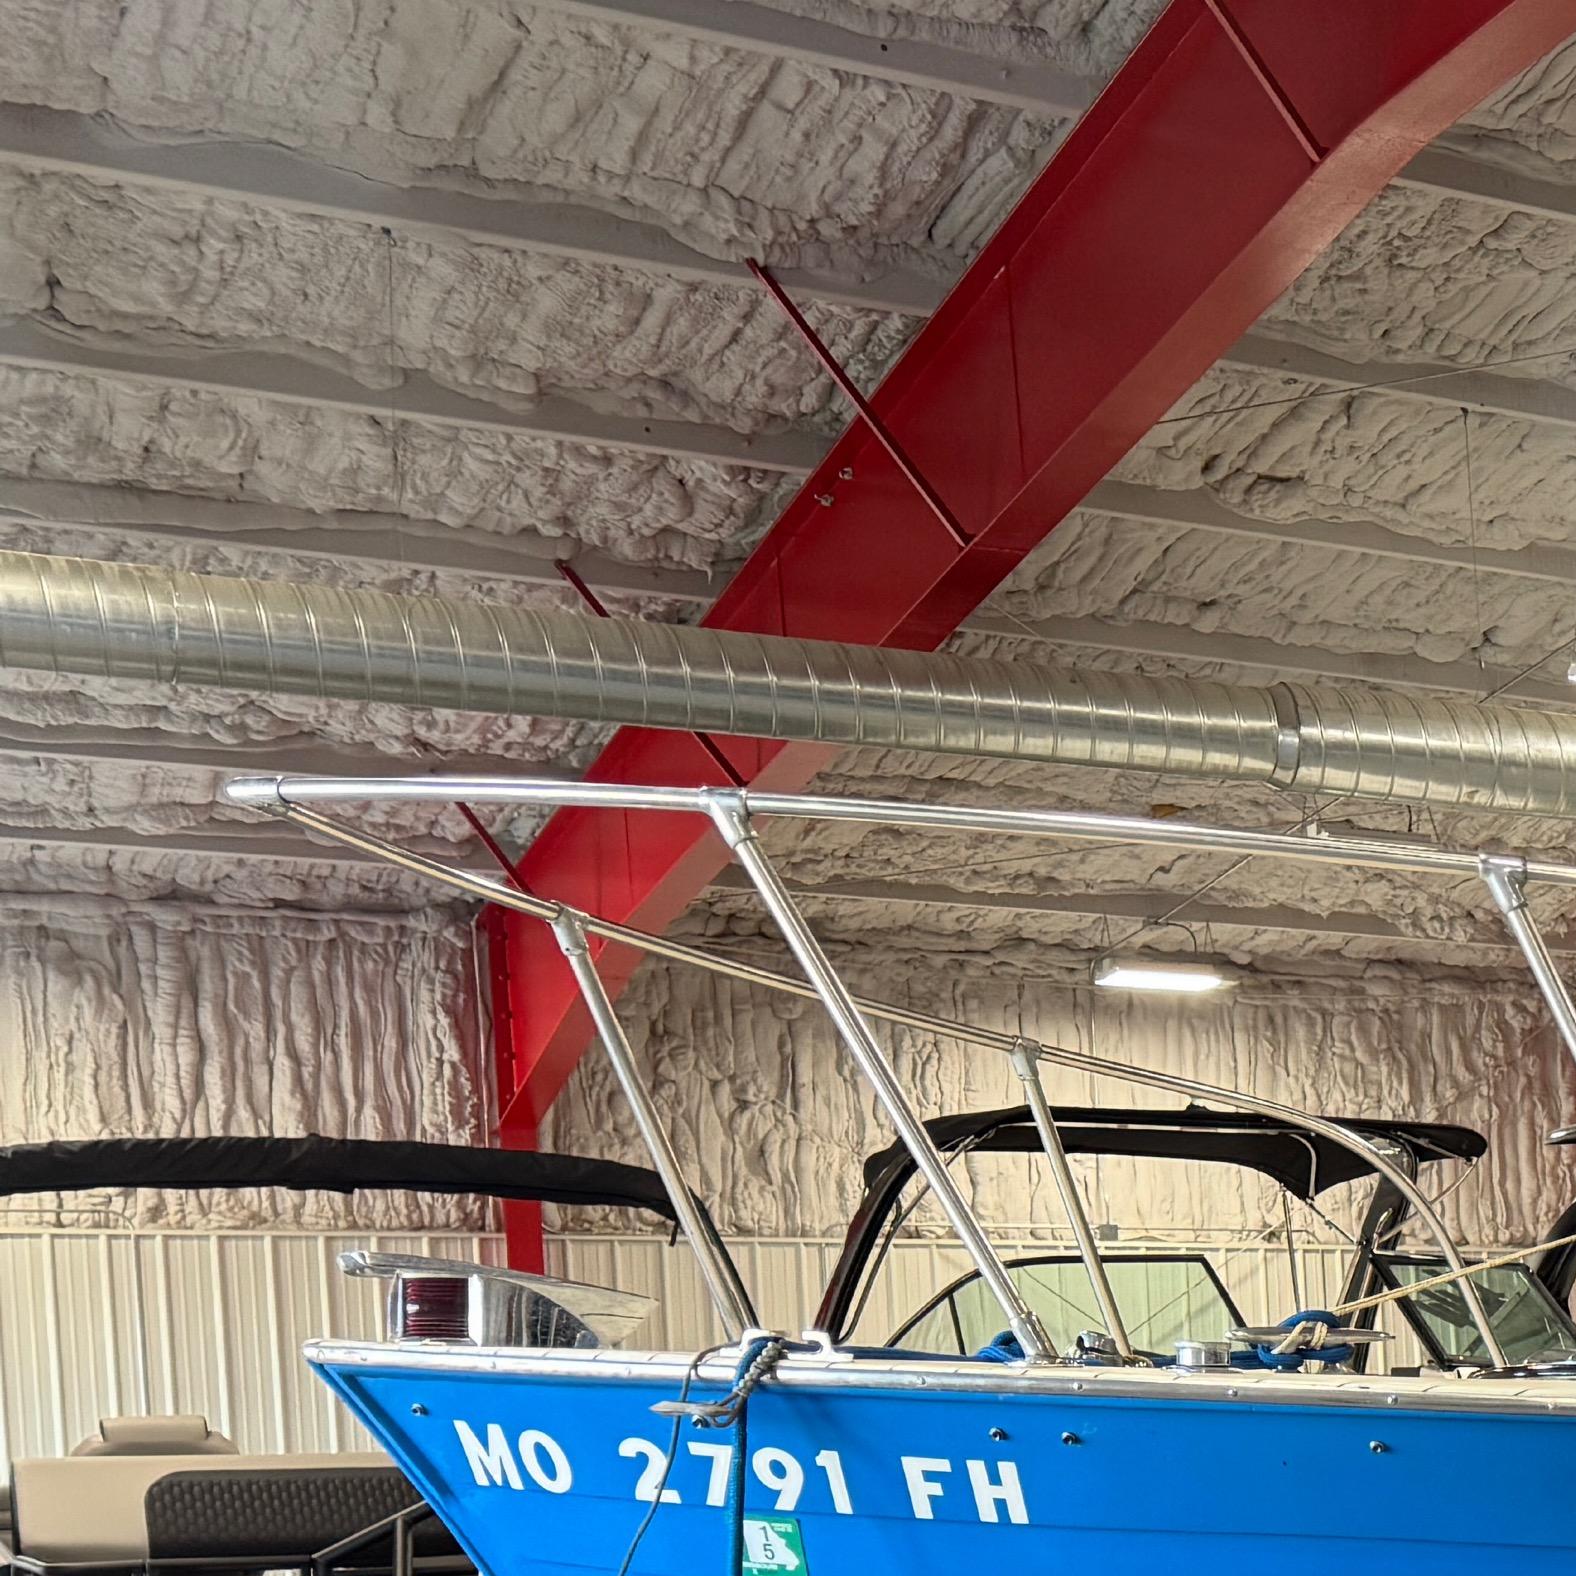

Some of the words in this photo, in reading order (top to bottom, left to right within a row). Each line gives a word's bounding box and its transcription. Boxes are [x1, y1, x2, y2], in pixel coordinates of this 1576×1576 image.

[453, 1420, 574, 1494] MO
[618, 1437, 853, 1515] 2791
[901, 1456, 1030, 1524] FH
